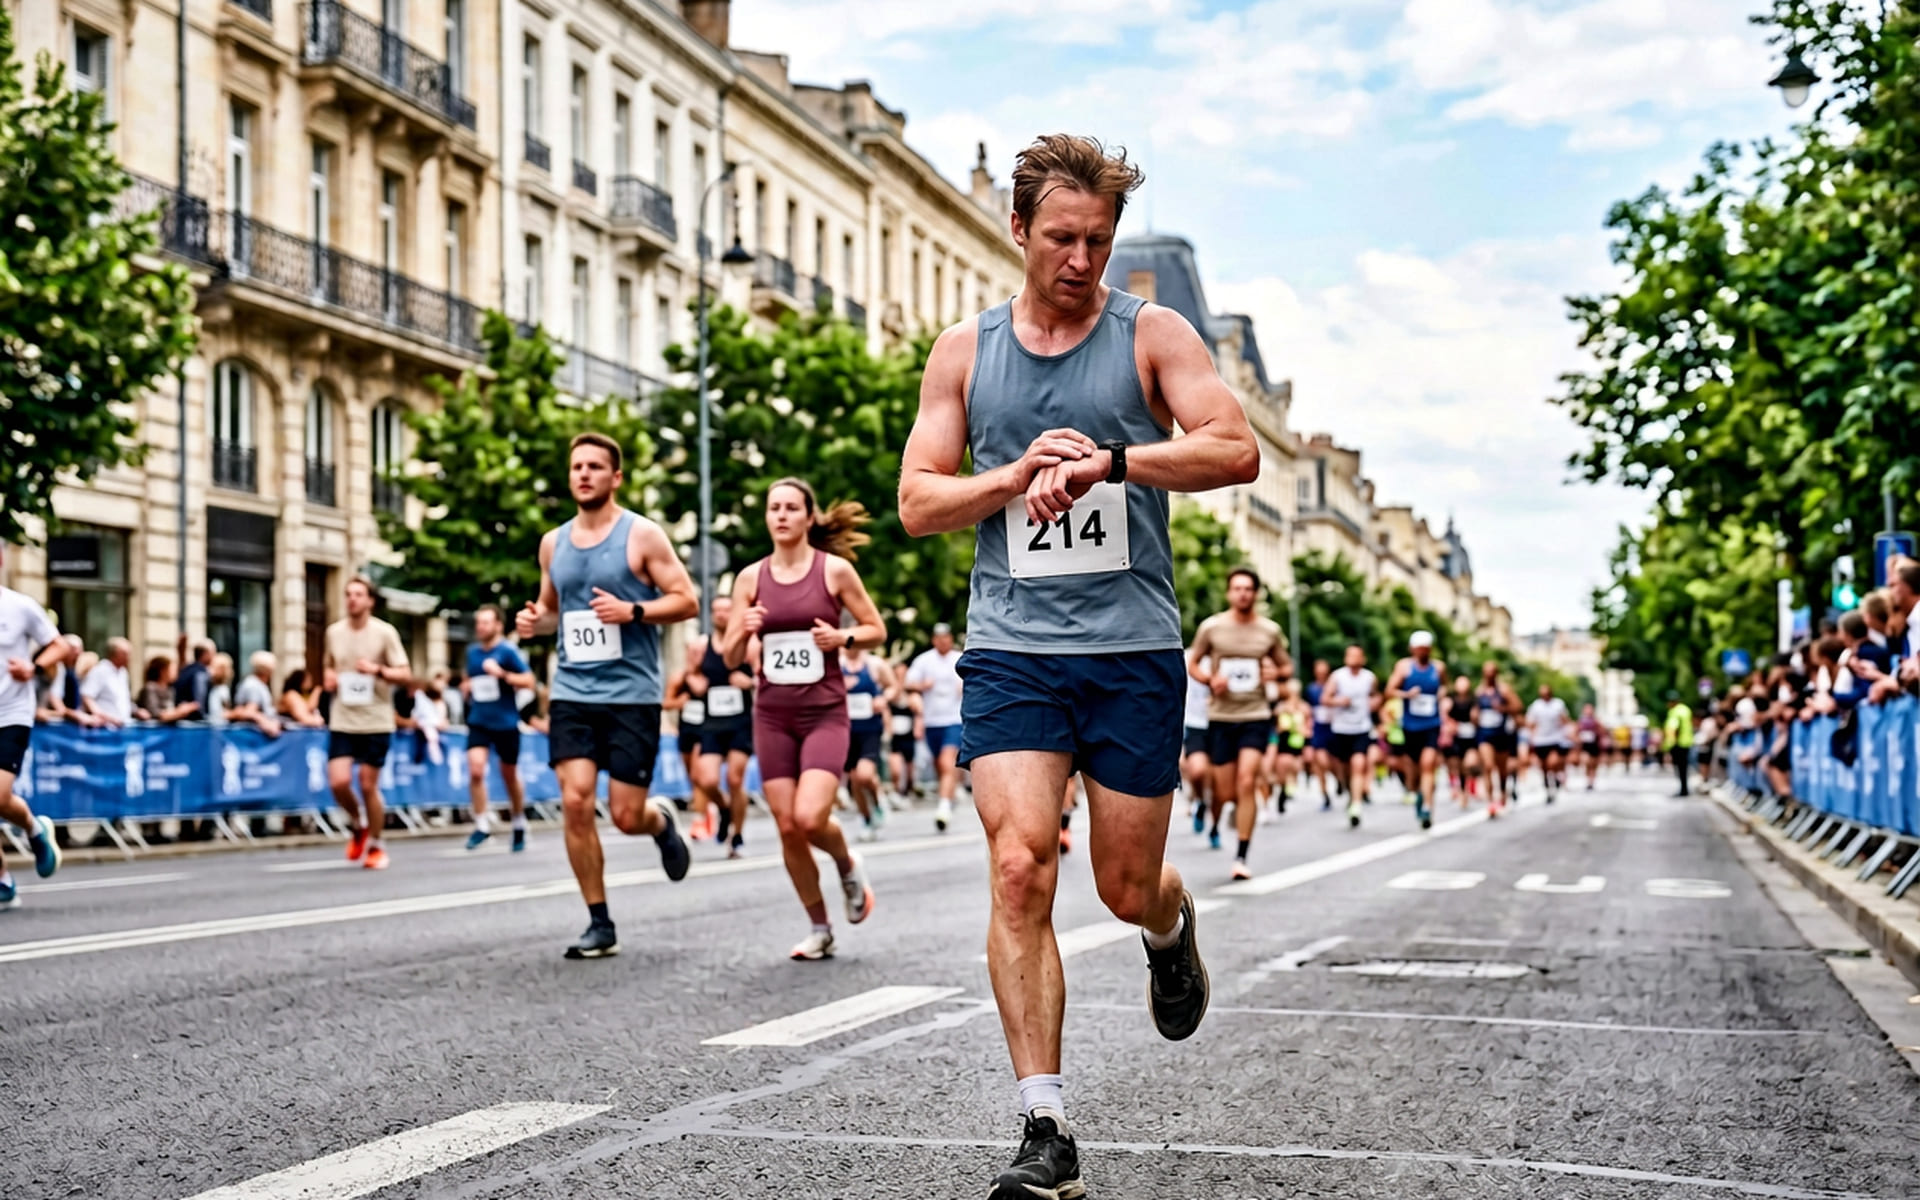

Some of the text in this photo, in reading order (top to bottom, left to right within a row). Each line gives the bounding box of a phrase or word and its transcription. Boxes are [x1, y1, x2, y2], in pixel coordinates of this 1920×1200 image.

[1027, 509, 1107, 551] 214
[573, 627, 606, 646] 301
[772, 649, 810, 669] 249
